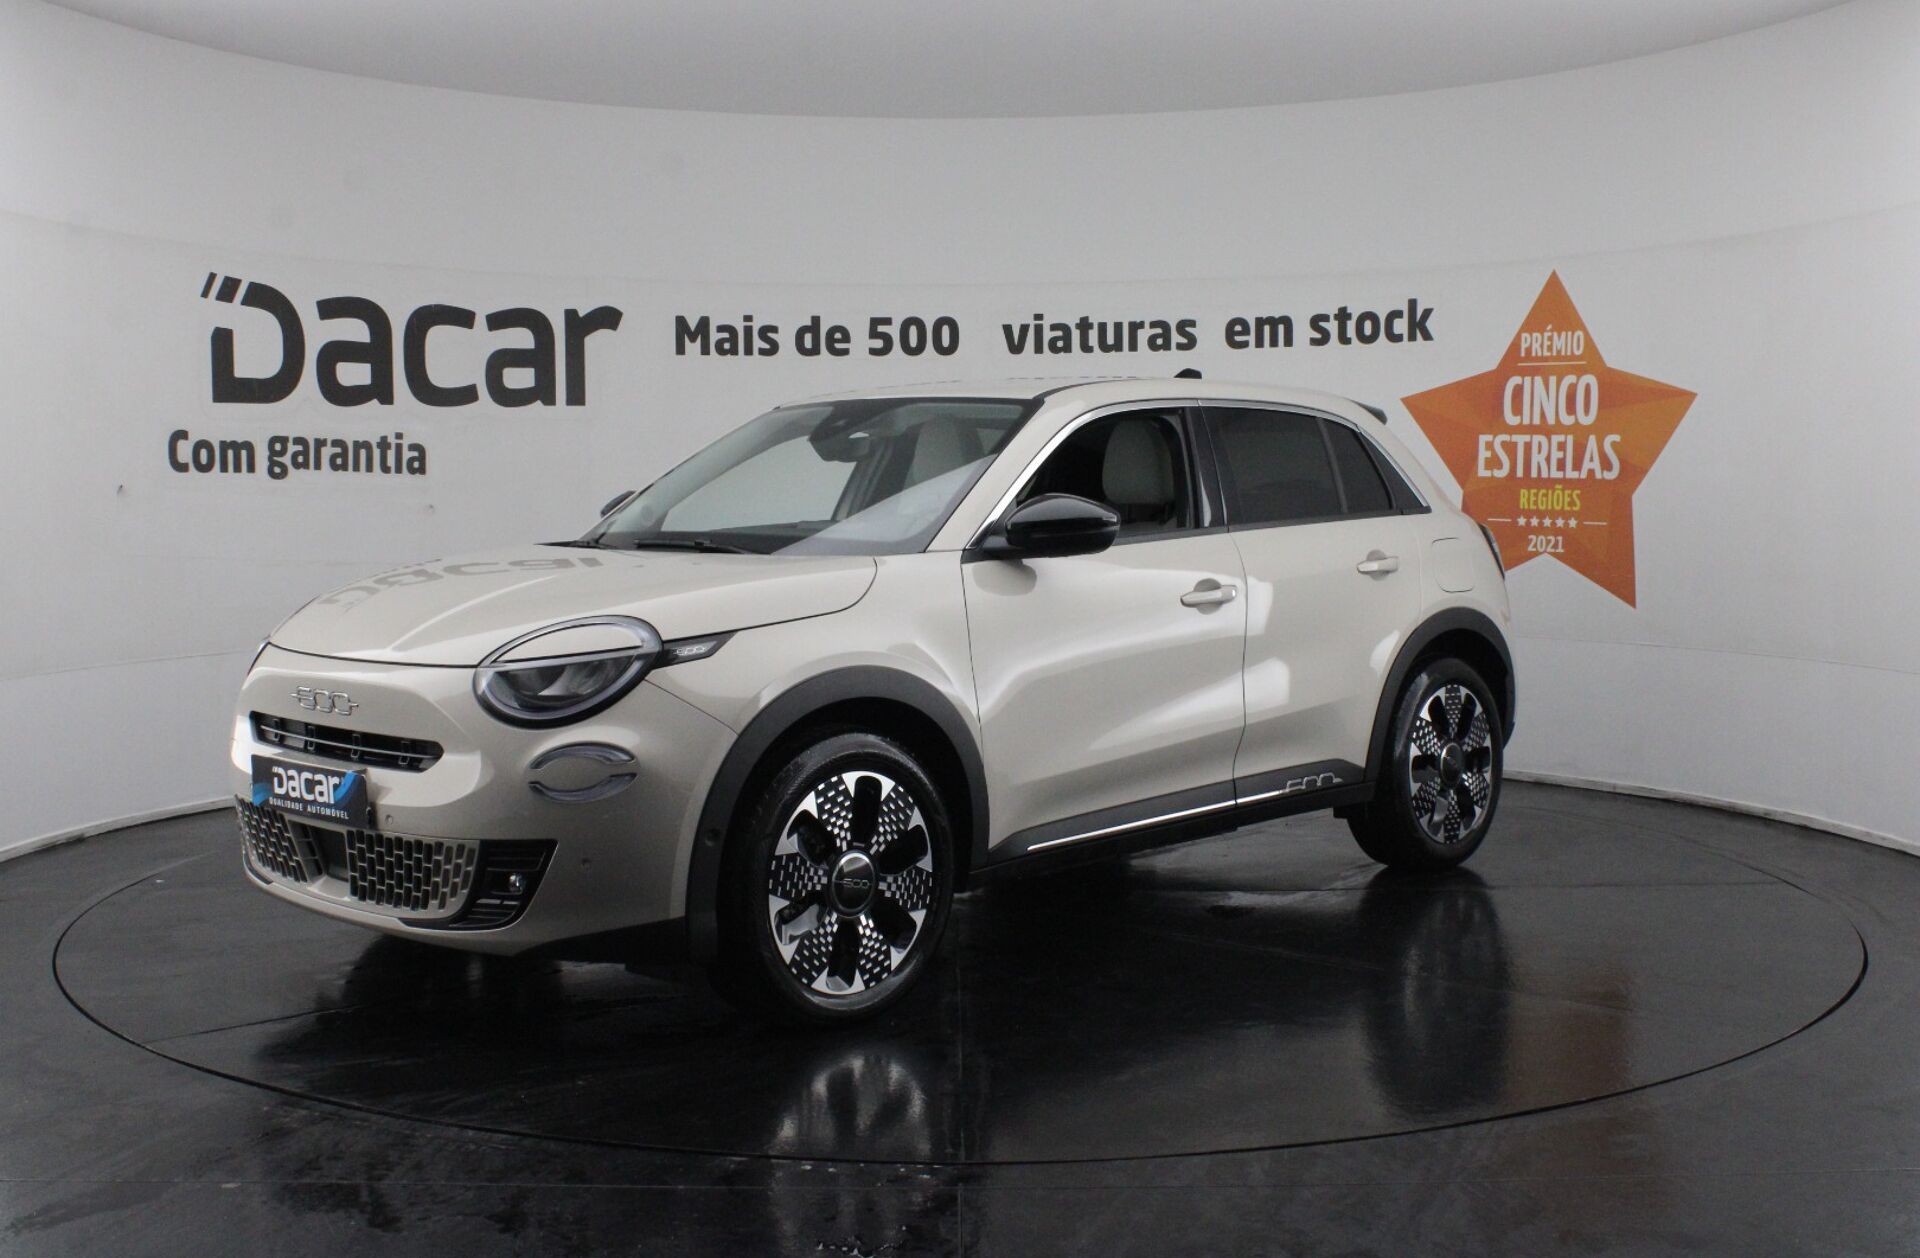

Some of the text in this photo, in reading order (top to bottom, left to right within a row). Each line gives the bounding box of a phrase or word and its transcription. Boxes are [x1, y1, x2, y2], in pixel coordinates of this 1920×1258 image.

[201, 272, 623, 407] Dacar
[674, 297, 1435, 357] Mais de 500 viaturas em stock
[1519, 324, 1585, 358] PRÉMIO
[1503, 373, 1599, 426] CINCO
[167, 429, 427, 481] Com garantia
[1477, 434, 1621, 481] ESTRELAS
[1519, 484, 1581, 512] REGIÕES
[1527, 534, 1565, 554] 2021
[268, 796, 304, 812] QUALIDADE
[271, 765, 340, 804] Dacar
